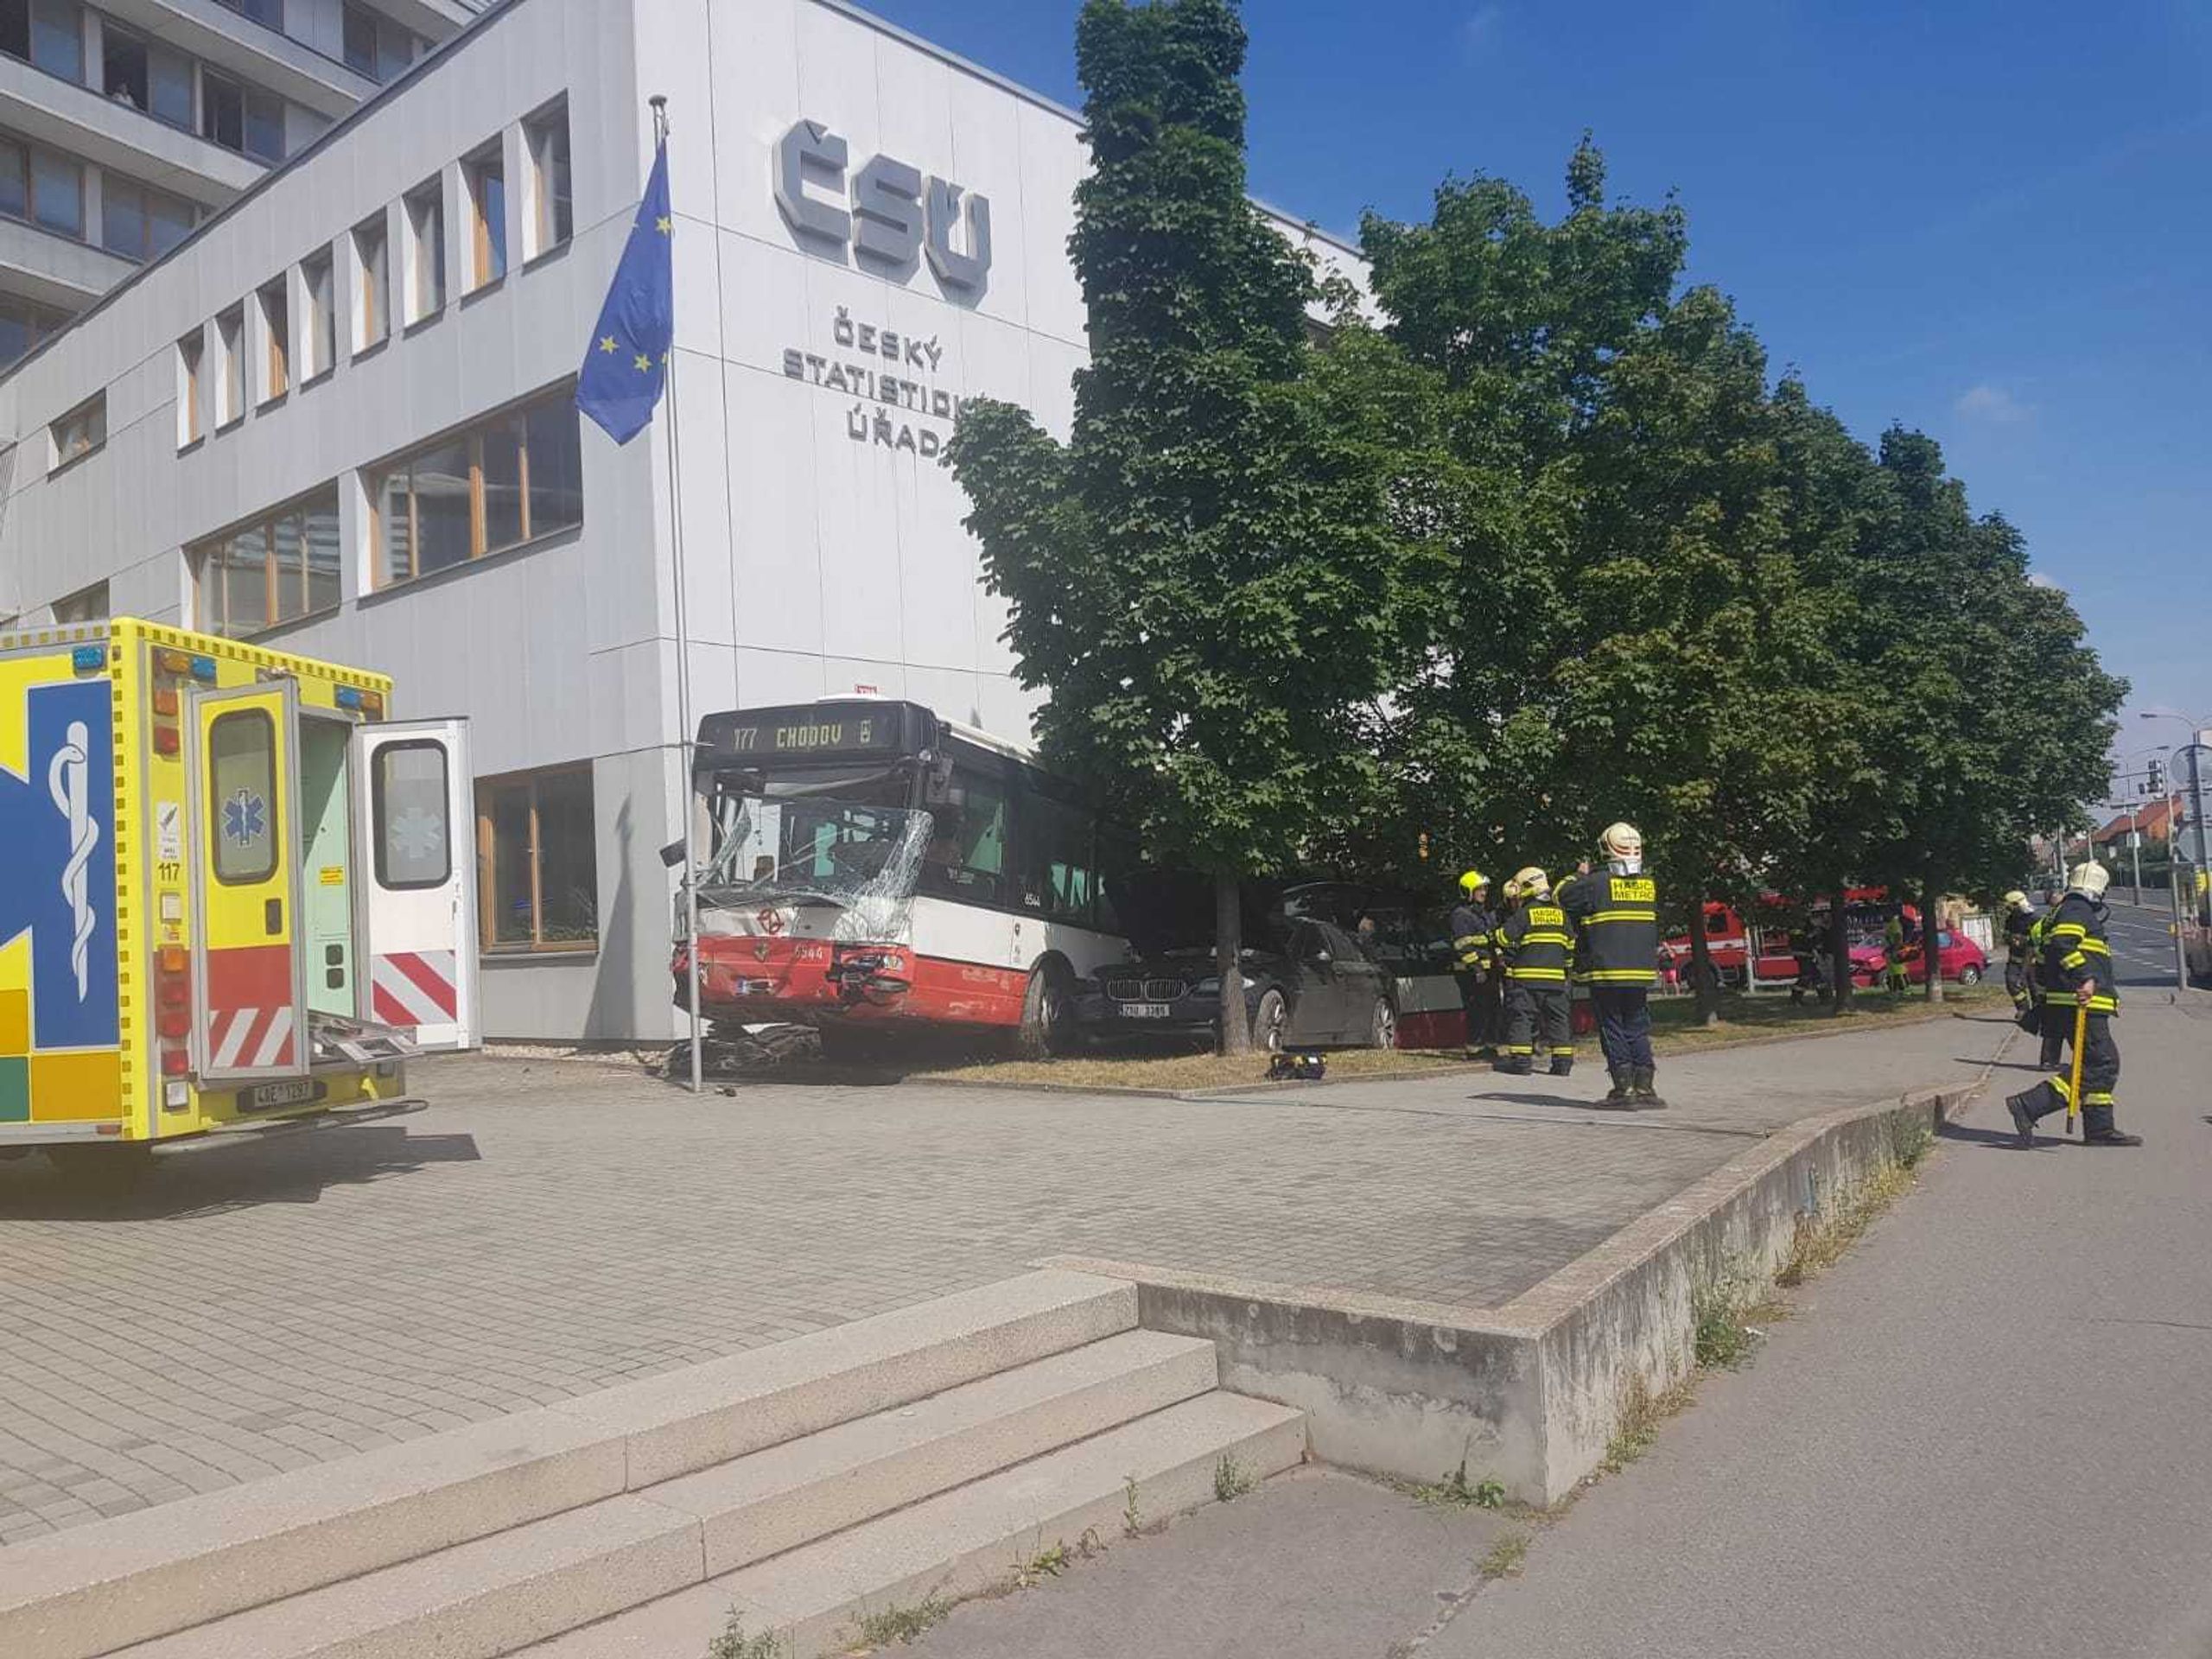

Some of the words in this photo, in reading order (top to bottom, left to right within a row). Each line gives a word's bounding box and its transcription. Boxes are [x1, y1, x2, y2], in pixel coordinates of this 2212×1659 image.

[834, 306, 942, 372] ČESKÝ
[847, 403, 939, 458] ÚŘAD
[778, 723, 842, 748] CHODOV
[158, 862, 180, 881] 117
